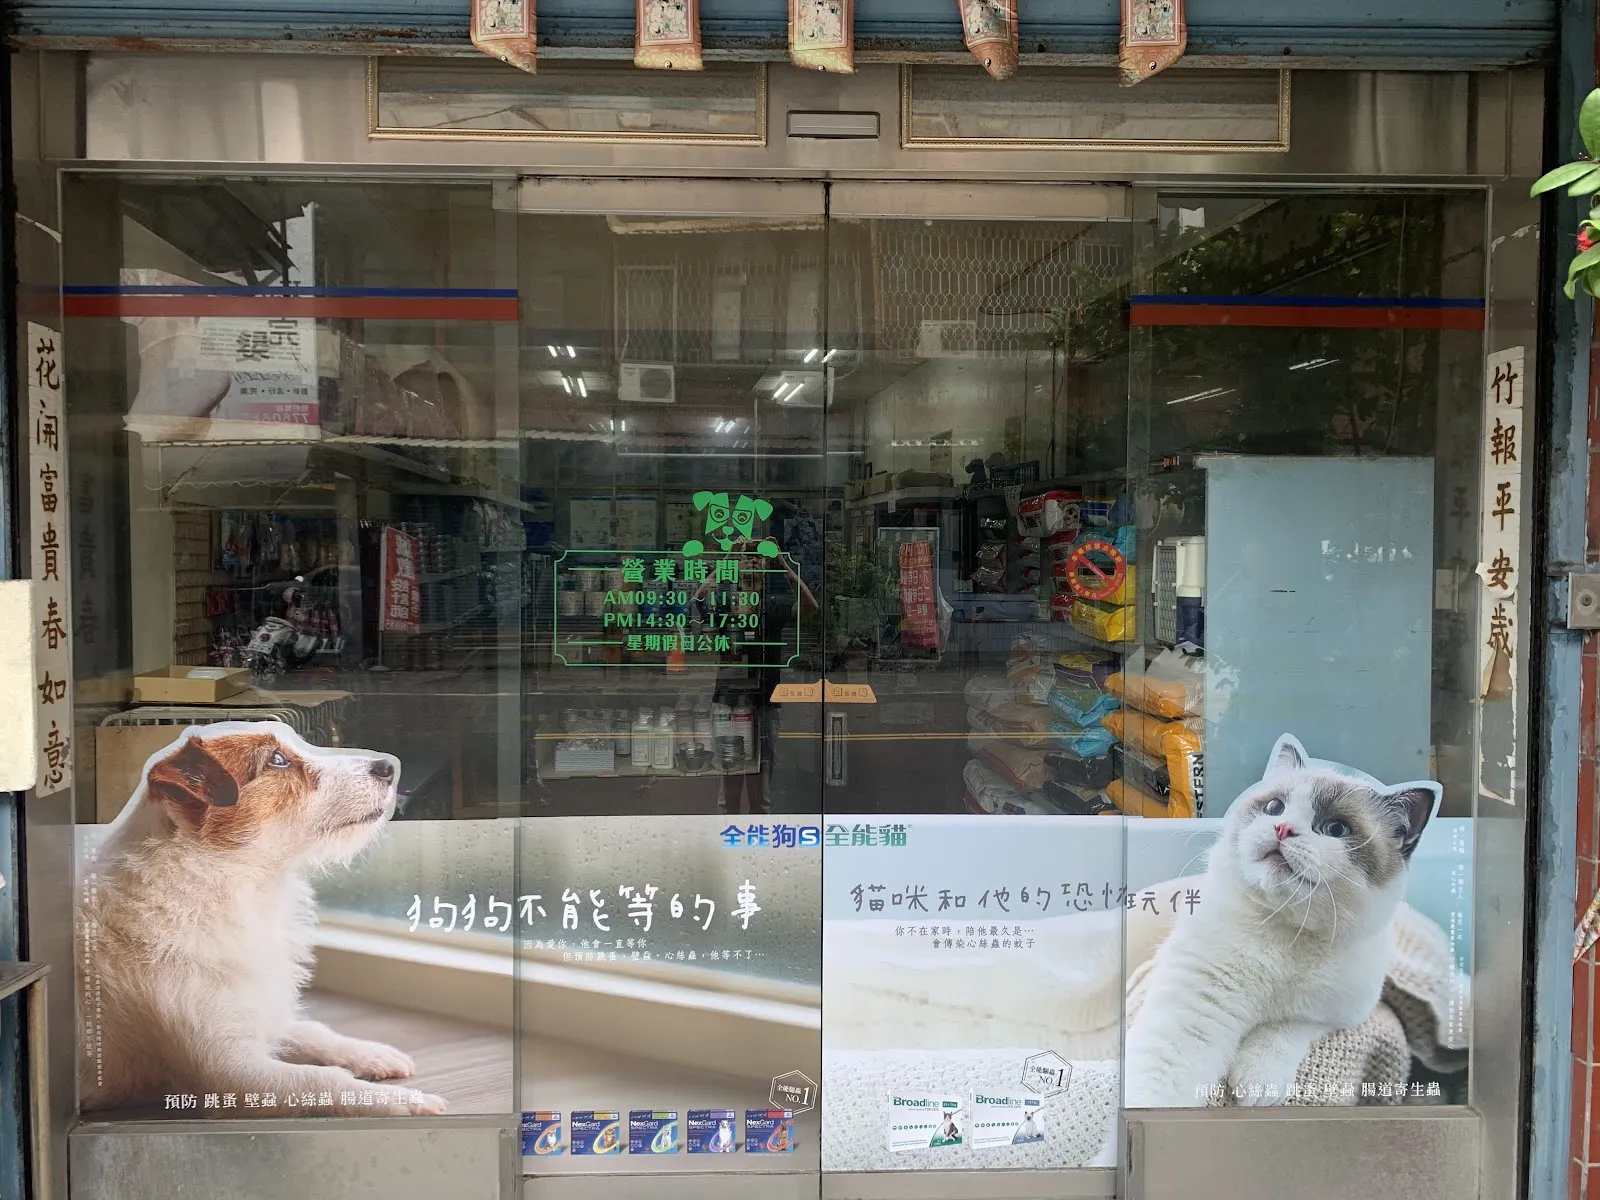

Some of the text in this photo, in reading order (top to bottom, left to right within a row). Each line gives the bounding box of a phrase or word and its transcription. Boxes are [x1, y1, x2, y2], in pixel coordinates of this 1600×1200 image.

[621, 558, 740, 584] 營業時間
[626, 634, 731, 652] 星期假日公休
[406, 879, 762, 932] 狗狗不能等的事
[931, 938, 1036, 950] 會傳染心絲蟲的蚊子
[1055, 1068, 1064, 1087] 1
[801, 1086, 810, 1106] 1
[1231, 1082, 1279, 1099] 心絲蟲
[1286, 1082, 1318, 1098] 跳蚤
[1361, 1080, 1441, 1098] 腸道寄生蟲
[164, 1093, 198, 1110] 預防
[204, 1093, 237, 1109] 跳蚤
[284, 1091, 334, 1108] 心絲蟲
[340, 1089, 425, 1106] 腸道寄生蟲
[893, 1096, 940, 1108] Broadline
[975, 1094, 1022, 1106] Broadline
